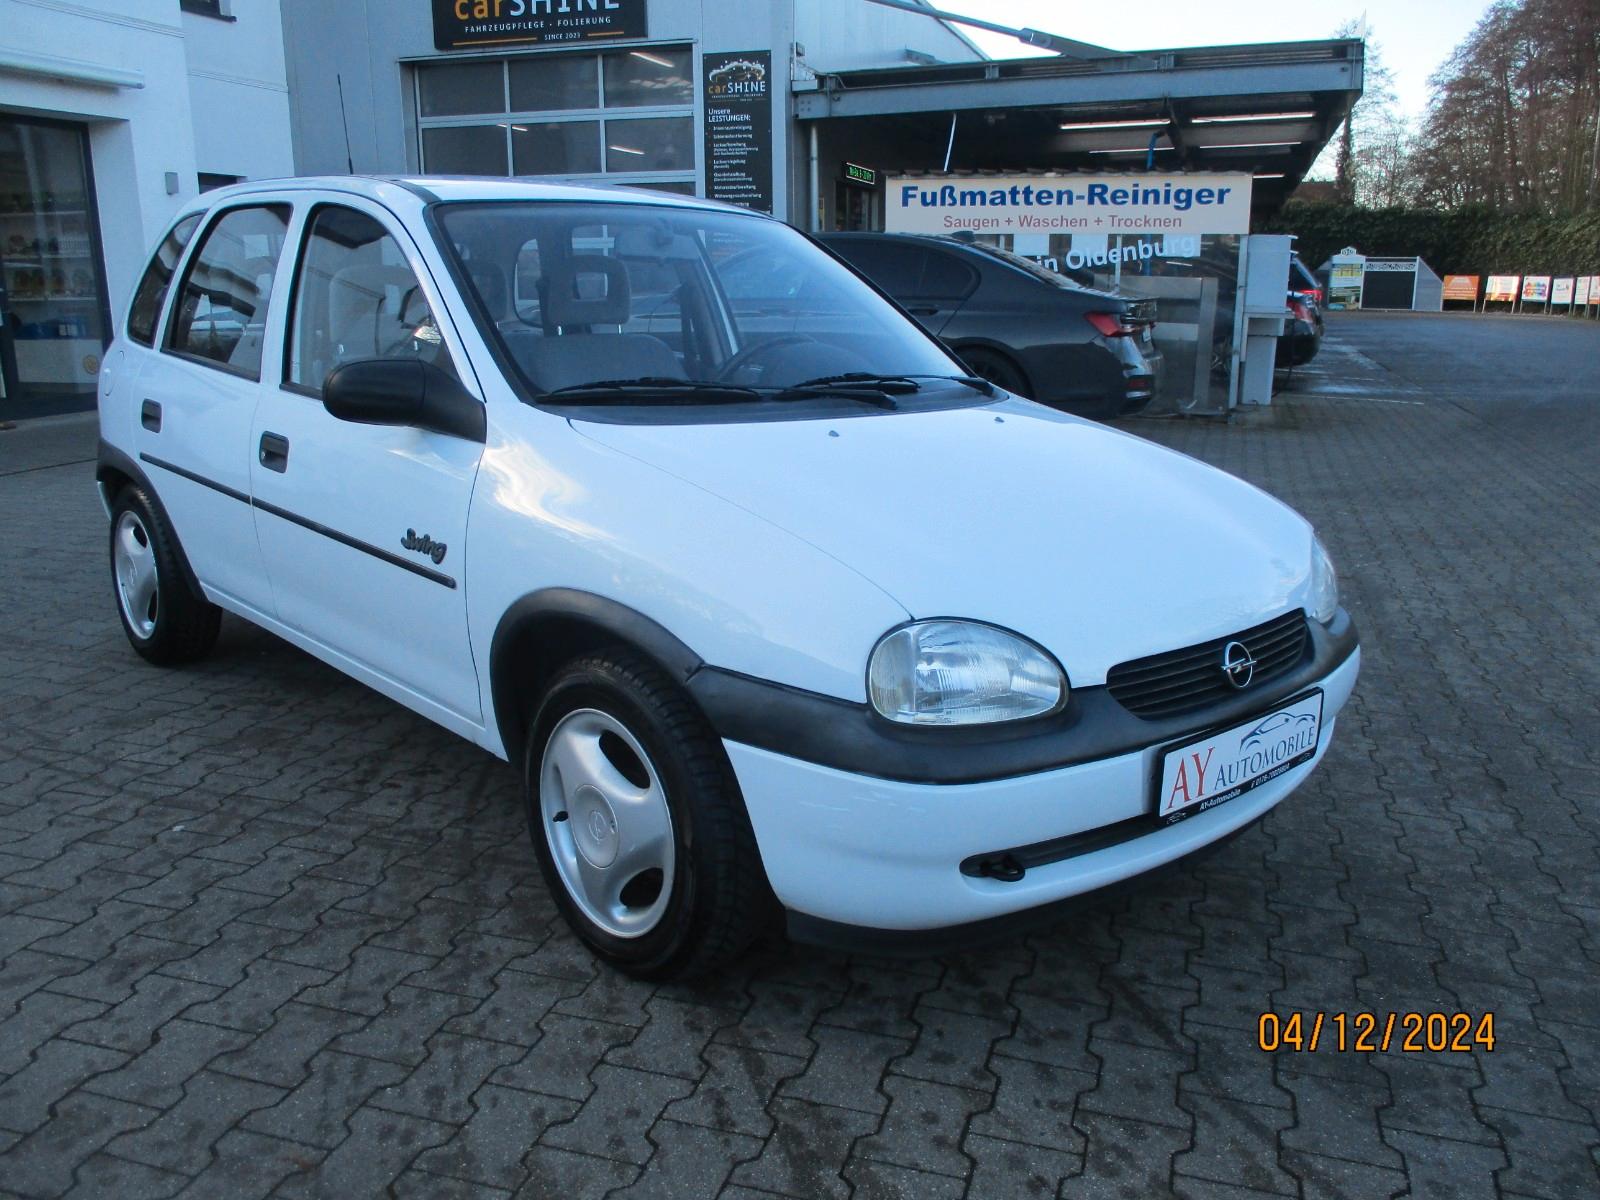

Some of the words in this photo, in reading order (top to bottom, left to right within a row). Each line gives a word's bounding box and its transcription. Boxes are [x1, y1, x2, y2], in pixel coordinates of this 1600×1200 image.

[465, 21, 545, 33] FAHRZEUGPFLEGE
[557, 16, 611, 27] FOLIERUNG
[544, 33, 563, 41] SINCE
[708, 81, 766, 94] carSHINE
[708, 114, 751, 123] LEISTUNGEN:
[901, 182, 1231, 211] Fußmatten-Reiniger
[943, 216, 999, 231] Saugen
[1018, 215, 1088, 228] Waschen
[1109, 214, 1183, 228] Trocknen
[1066, 236, 1197, 271] Oldenburg
[1165, 746, 1216, 809] AY
[1214, 726, 1315, 791] AUTOMOBILE
